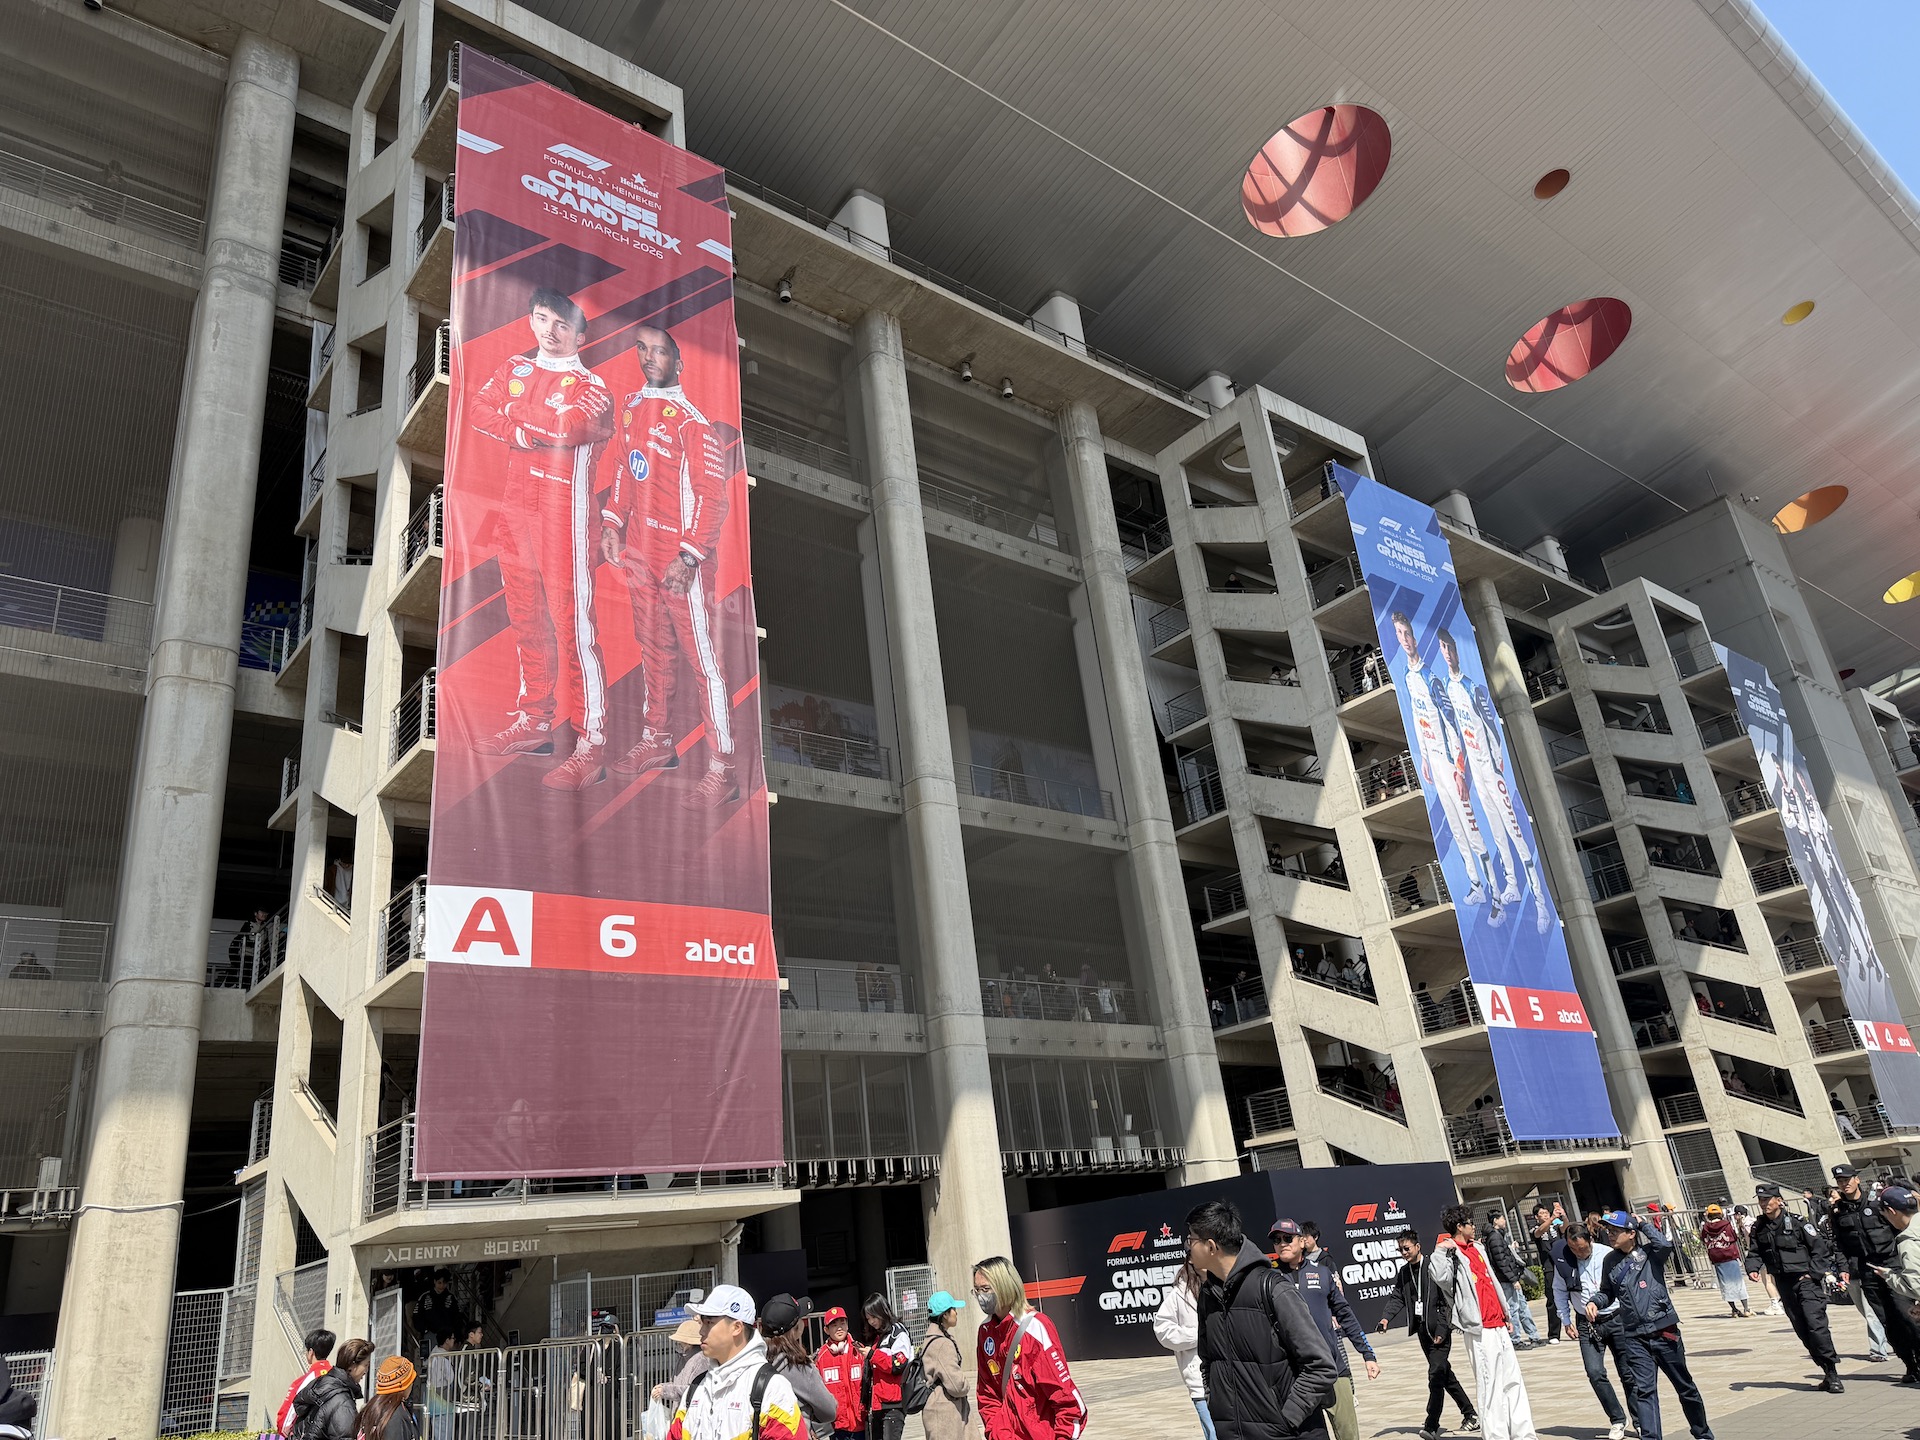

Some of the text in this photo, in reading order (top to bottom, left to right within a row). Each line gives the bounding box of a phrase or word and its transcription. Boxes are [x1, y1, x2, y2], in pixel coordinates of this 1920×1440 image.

[546, 143, 612, 172] F1
[543, 154, 662, 211] FORMULA 1 HEINEKEN
[620, 176, 660, 199] Heineken
[548, 169, 658, 228] CHINESE
[520, 174, 683, 256] GRAND PRIX
[543, 202, 664, 260] 13-15 MARCH 2026
[523, 422, 547, 435] RICHARD
[631, 450, 647, 480] hp
[659, 523, 678, 533] LEWIS
[1377, 543, 1439, 578] GRAND PRIX
[1383, 536, 1427, 562] CHINESE
[451, 896, 756, 966] A 6 abcd
[1490, 989, 1583, 1025] A 5 abcd
[1863, 1024, 1879, 1047] A
[1884, 1027, 1895, 1046] 4
[1345, 1204, 1378, 1225] F1
[1107, 1231, 1147, 1254] F1
[1153, 1235, 1182, 1248] Heineken
[1345, 1227, 1375, 1239] FORMULA
[1375, 1227, 1379, 1237] 1
[383, 1239, 540, 1263] 入口 ENTRY 出口 EXIT
[1106, 1250, 1187, 1268] FORMULA 1 HEINEKEN
[1342, 1261, 1396, 1285] GRAND
[1099, 1287, 1161, 1311] GRAND
[1358, 1288, 1379, 1300] 13-15
[1114, 1313, 1138, 1325] 13-15
